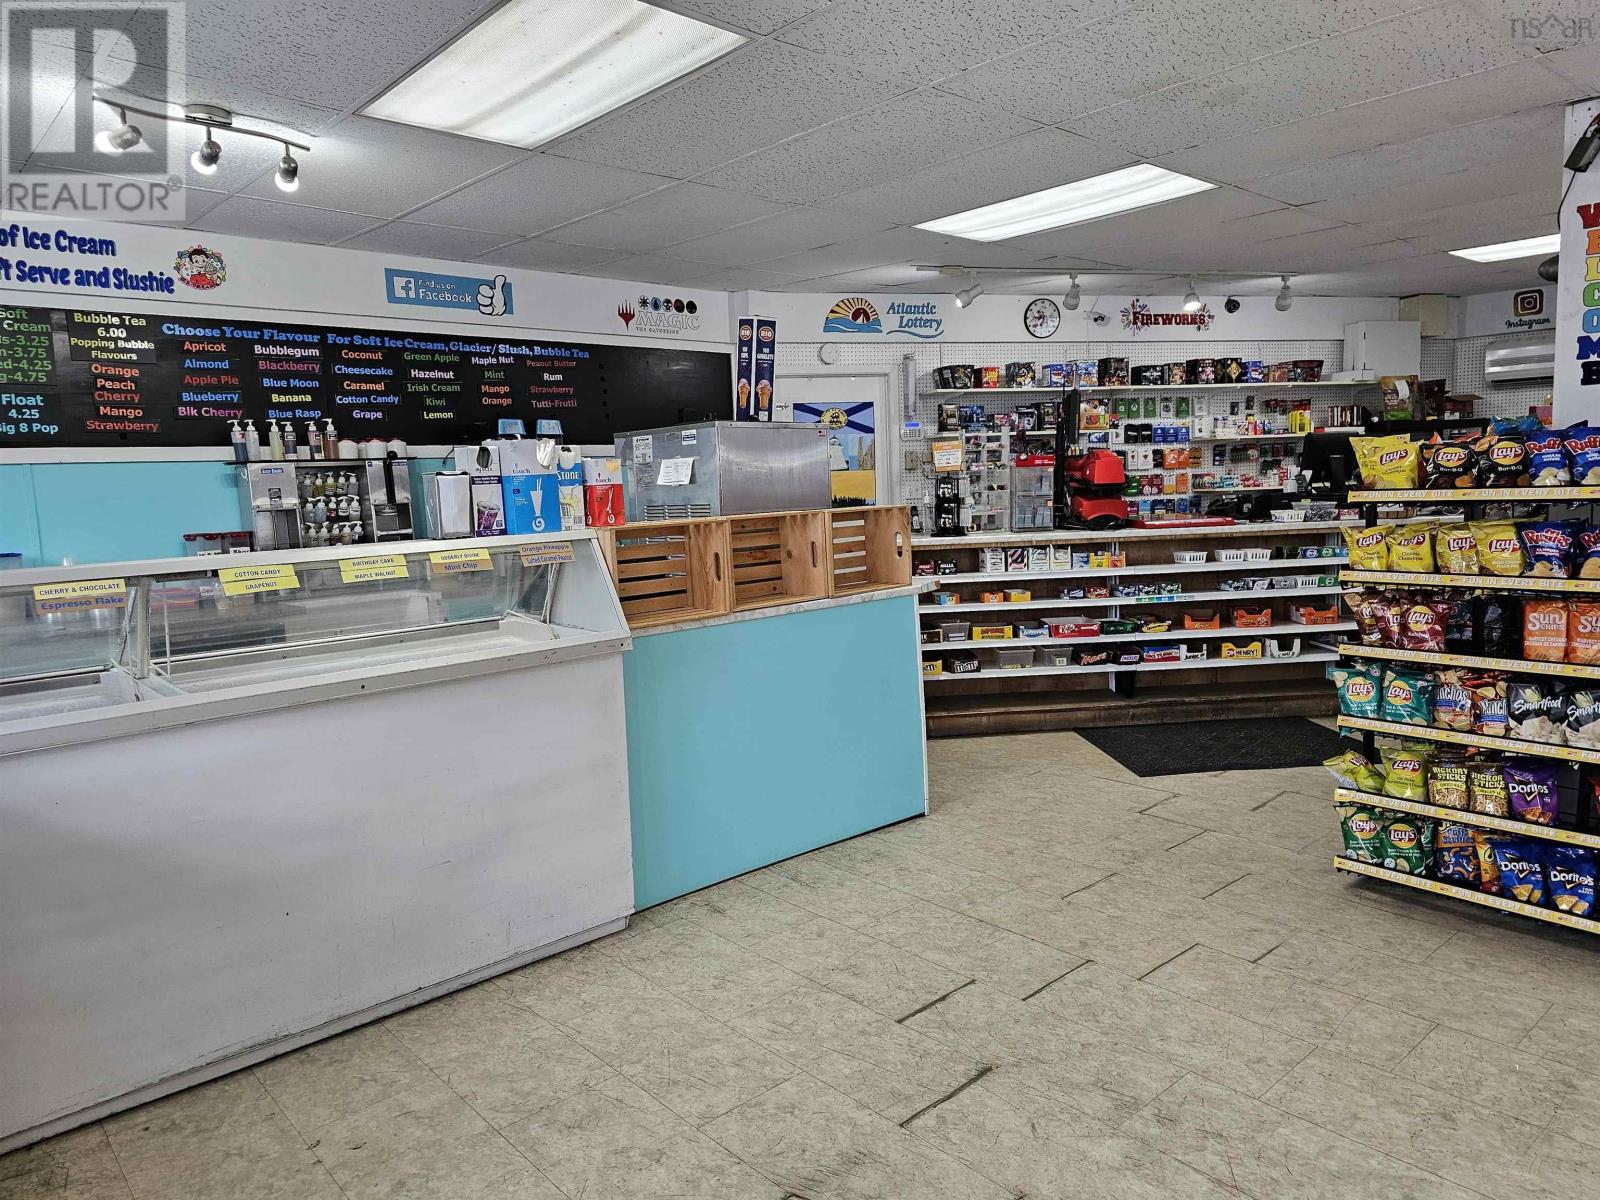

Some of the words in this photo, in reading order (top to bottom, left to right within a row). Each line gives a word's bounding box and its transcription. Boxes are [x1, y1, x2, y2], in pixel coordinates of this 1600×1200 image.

[0, 224, 20, 247] of
[23, 226, 51, 249] Ice
[55, 229, 117, 256] Cream
[16, 260, 70, 285] Serve
[74, 266, 112, 289] and
[113, 267, 175, 294] Slushie
[419, 289, 472, 303] Facebook
[887, 302, 936, 315] Atlantic
[74, 313, 120, 325] Bubble
[122, 315, 147, 326] Tea
[636, 311, 701, 331] MAGIC
[899, 315, 943, 331] Lottery
[1505, 318, 1550, 330] Instagram
[3, 321, 51, 332] Cream
[97, 328, 127, 338] 6.00
[71, 338, 115, 349] Popping
[118, 340, 155, 349] Bubble
[162, 323, 221, 337] Choose
[221, 326, 261, 339] Your
[263, 329, 321, 343] Flavour
[326, 333, 351, 344] For
[353, 335, 381, 346] Soft
[384, 337, 403, 348] Ice
[404, 338, 449, 352] Cream,
[450, 341, 497, 355] Glacier/
[498, 344, 533, 356] Slush,
[533, 346, 571, 357] Bubble
[571, 349, 590, 359] Tea
[183, 341, 227, 352] Apricot
[91, 351, 138, 360] Flavours
[254, 344, 320, 358] Bubblegum
[341, 350, 383, 360] Coconut
[184, 358, 229, 369] Almond
[404, 353, 432, 361] Green
[433, 353, 460, 363] Apple
[471, 356, 497, 365] Maple
[499, 356, 514, 364] Nut
[91, 364, 140, 377] Orange
[258, 361, 321, 373] Blackberry
[335, 365, 393, 376] Cheesecake
[411, 369, 454, 379] Hazelnut
[485, 370, 505, 379] Mint
[543, 372, 563, 381] Rum
[97, 379, 135, 390] Peach
[184, 375, 218, 386] Apple
[221, 375, 239, 385] Pie
[263, 378, 288, 388] Blue
[290, 379, 319, 388] Moon
[343, 382, 385, 391] Caramel
[407, 383, 429, 392] Irish
[431, 384, 460, 392] Cream
[481, 385, 510, 395] Mango
[530, 385, 574, 395] Strawberry
[2, 394, 44, 406] Float
[95, 391, 140, 403] Cherry
[182, 392, 239, 403] Blueberry
[271, 394, 312, 403] Banana
[336, 395, 368, 405] Cotton
[370, 395, 399, 405] Candy
[426, 397, 446, 406] Kiwi
[482, 397, 512, 406] Orange
[531, 400, 577, 409] Tutti-Frutti
[8, 409, 40, 419] 4.25
[100, 407, 143, 418] Mango
[178, 406, 198, 417] Blk
[201, 407, 243, 419] Cherry
[268, 410, 293, 418] Blue
[295, 410, 321, 420] Rasp
[352, 410, 383, 420] Grape
[423, 411, 453, 419] Lemon
[20, 423, 29, 432] 8
[33, 424, 59, 435] Pop
[86, 420, 159, 432] Strawberry
[1381, 449, 1408, 465] Lay's
[1437, 450, 1466, 464] Lay's
[1492, 446, 1522, 460] Lay's
[1358, 534, 1383, 547] Lay's
[1448, 537, 1475, 552] Lay's
[1491, 538, 1520, 553] Lay's
[543, 544, 569, 552] Pineapple
[352, 559, 379, 567] BIRTHDAY
[462, 563, 478, 571] Chip
[234, 570, 259, 578] COTTON
[354, 572, 374, 580] MAPLE
[375, 570, 396, 578] WALNUT
[39, 588, 68, 596] CHERRY
[79, 583, 120, 592] CHOCOLATE
[246, 581, 277, 590] GRAPENUT
[41, 600, 92, 611] Espresso
[95, 596, 125, 605] Flake
[1408, 611, 1434, 625] Lay's
[1528, 612, 1560, 631] Sun
[1348, 683, 1374, 696] Lay's
[1388, 685, 1411, 699] Lay's
[1514, 696, 1562, 714] Smartfood
[1392, 760, 1420, 774] Lay's
[1433, 767, 1467, 775] HICKORY
[1437, 773, 1466, 781] STICKS
[1474, 780, 1505, 788] STICKS
[1509, 783, 1549, 795] Doritos
[1391, 830, 1415, 841] Lay's
[1501, 861, 1541, 872] Doritos
[1551, 871, 1594, 886] Doritos
